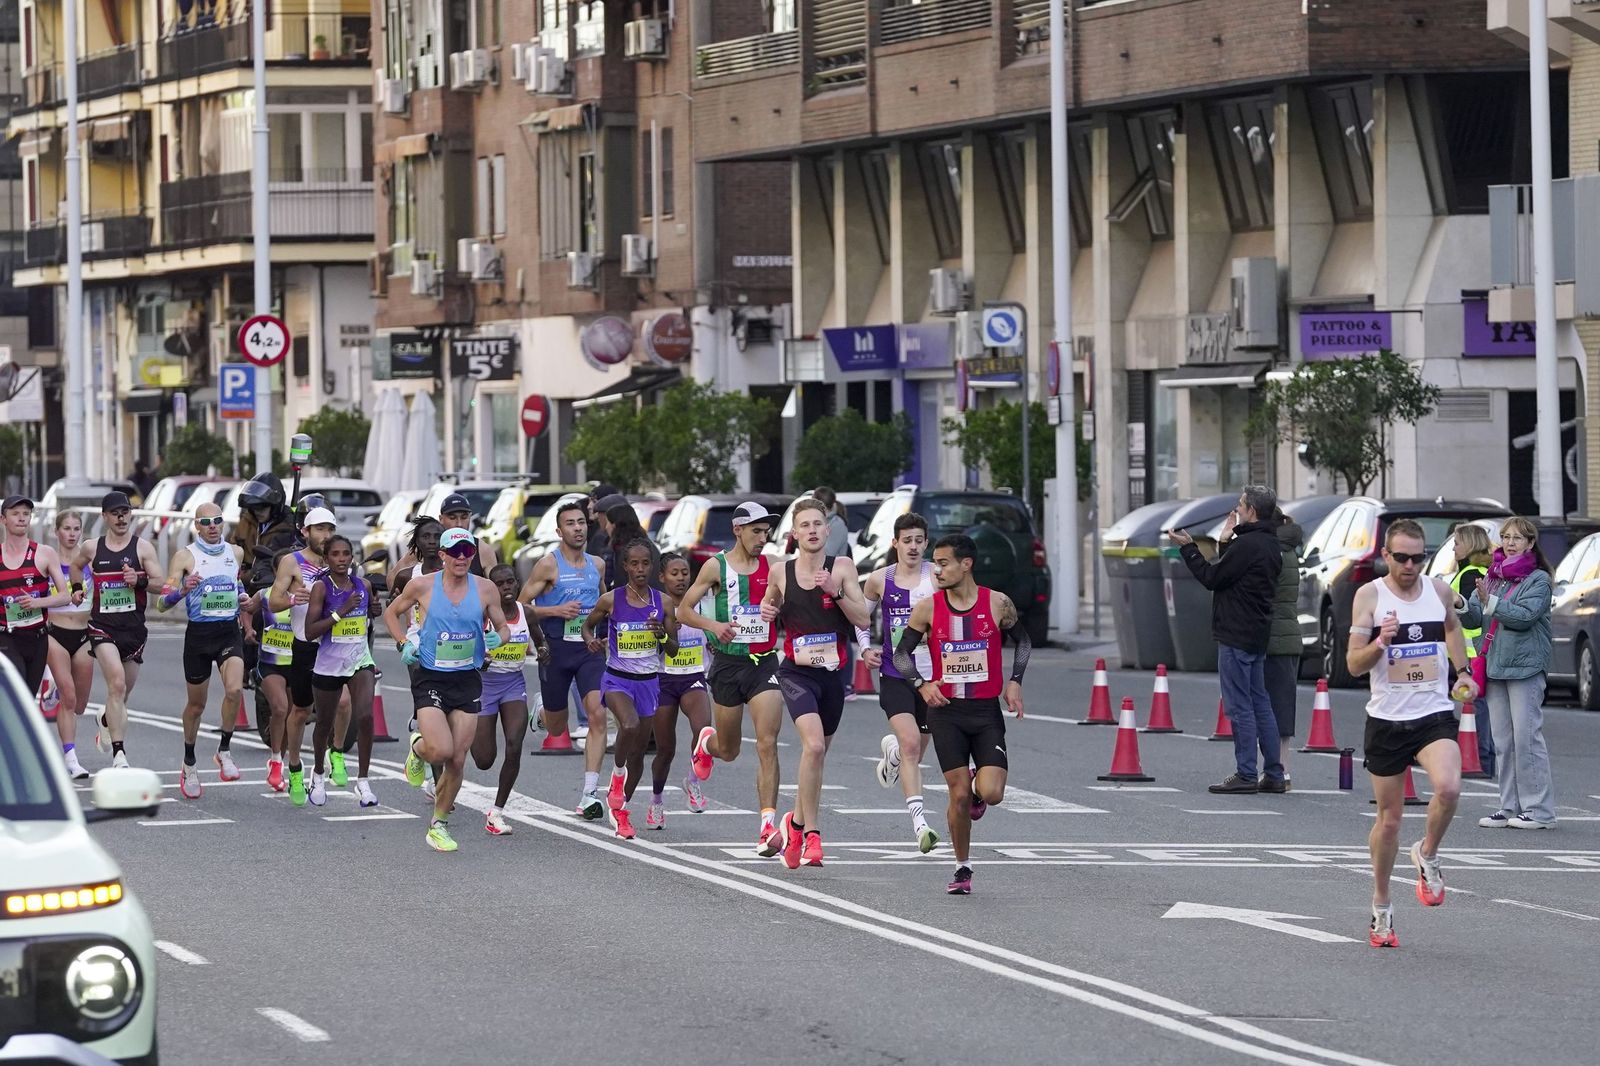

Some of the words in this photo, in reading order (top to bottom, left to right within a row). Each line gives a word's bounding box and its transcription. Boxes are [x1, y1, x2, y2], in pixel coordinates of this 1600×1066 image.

[1310, 320, 1366, 332] TATTOO
[1371, 320, 1382, 331] &
[1311, 334, 1382, 346] PIERCING
[453, 340, 510, 356] TINTE
[468, 354, 504, 380] 5€
[224, 368, 246, 399] P
[16, 610, 32, 620] SAM
[342, 628, 360, 636] URGE
[740, 626, 764, 634] PACER
[618, 640, 657, 650] BUZUNESH
[956, 643, 981, 651] ZURICH
[1406, 647, 1432, 656] ZURICH
[672, 658, 696, 666] MULAT
[810, 656, 825, 664] 260
[946, 662, 984, 674] PEZUELA
[1406, 671, 1424, 682] 199
